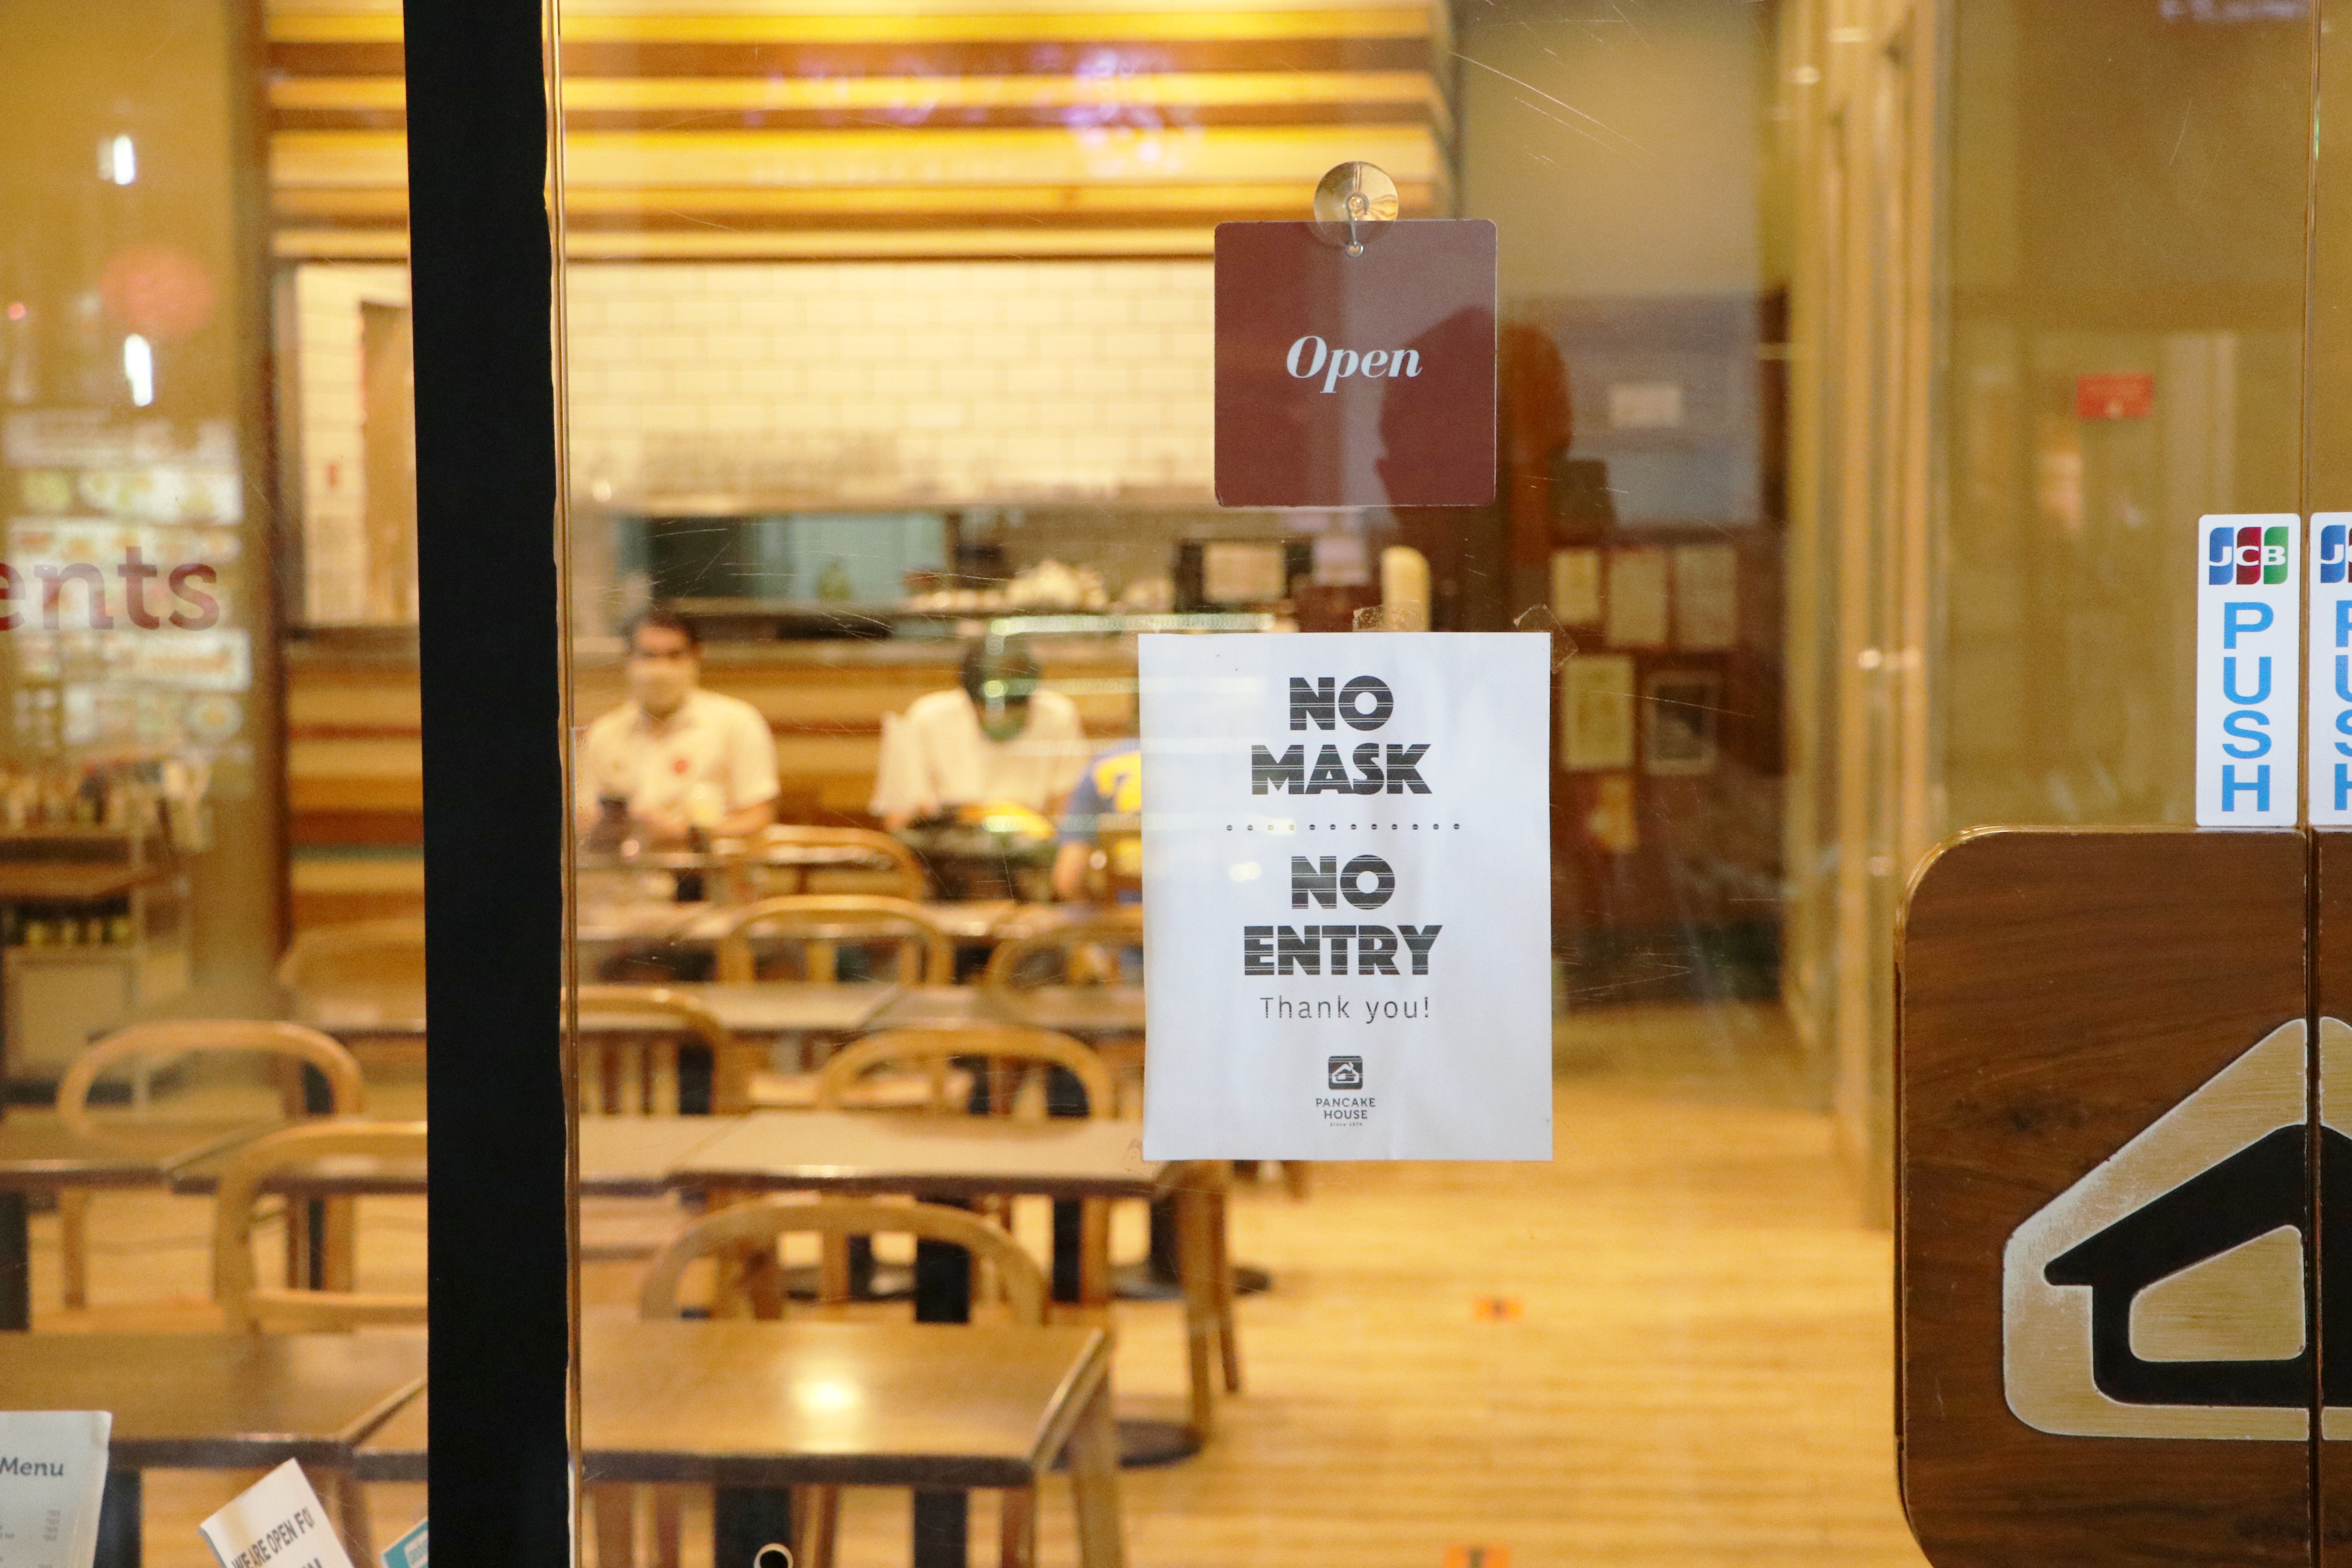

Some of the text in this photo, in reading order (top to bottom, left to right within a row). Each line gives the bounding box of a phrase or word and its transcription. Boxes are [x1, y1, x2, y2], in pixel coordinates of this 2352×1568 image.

[1286, 336, 1422, 393] Open
[1290, 675, 1394, 731] NO
[2221, 602, 2274, 812] PUSH
[1252, 742, 1432, 795] MASK
[1291, 855, 1396, 910] NO
[1244, 925, 1443, 976] ENTRY
[1260, 995, 1430, 1024] Thank you!
[1316, 1098, 1376, 1107] PANCAKE
[1324, 1110, 1368, 1119] HOUSE
[0, 1457, 64, 1477] Menu
[248, 1539, 271, 1566] ARE
[267, 1519, 298, 1555] OPEN
